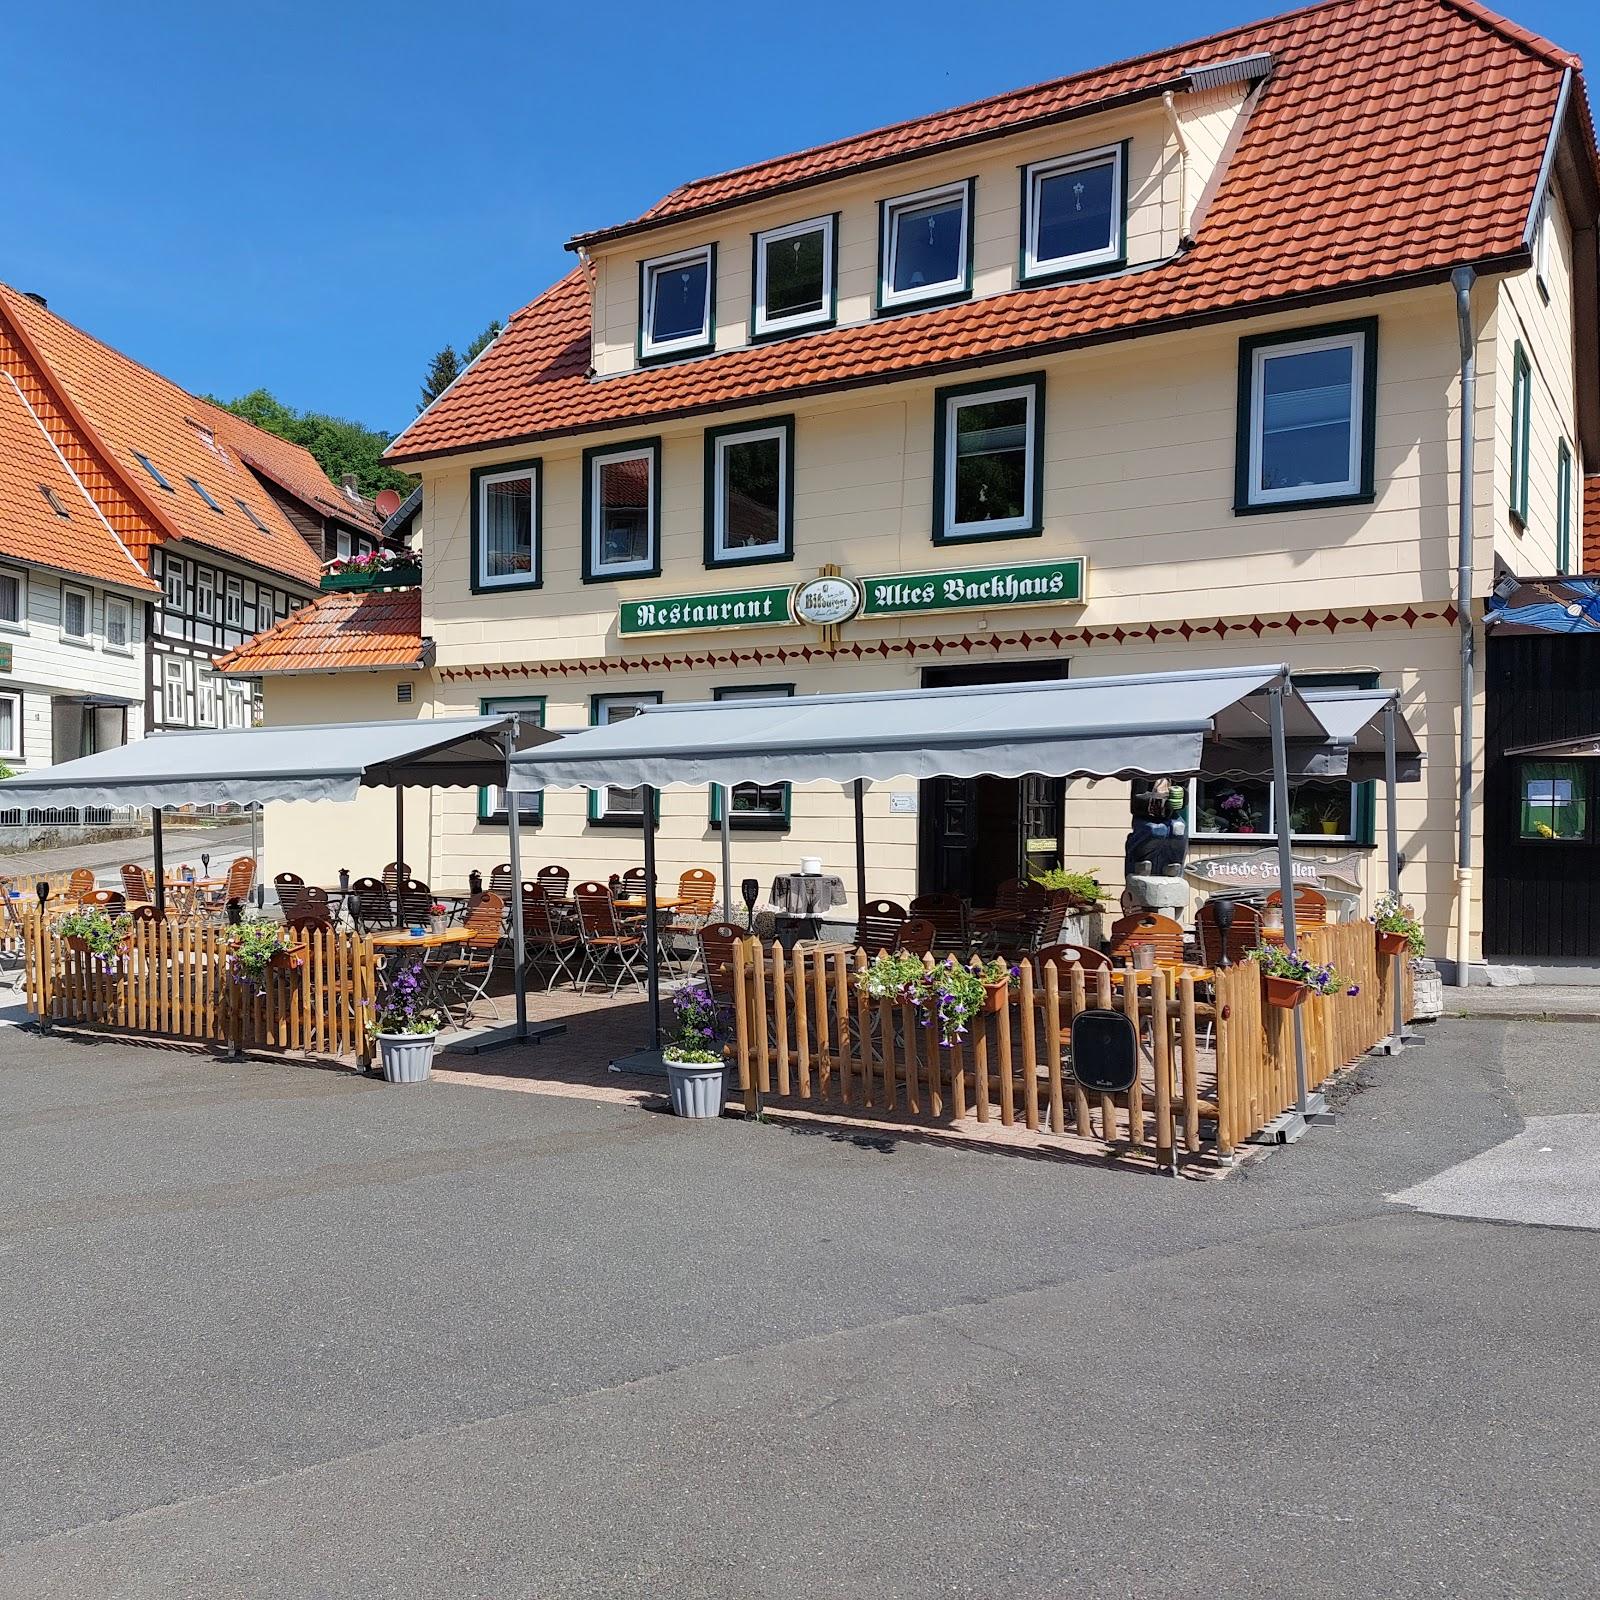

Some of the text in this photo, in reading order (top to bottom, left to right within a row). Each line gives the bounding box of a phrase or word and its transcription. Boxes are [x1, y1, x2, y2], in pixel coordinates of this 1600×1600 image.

[874, 571, 1064, 607] Altes Backhaus
[637, 595, 772, 627] Restaurant
[1206, 861, 1317, 879] Frische Follen
